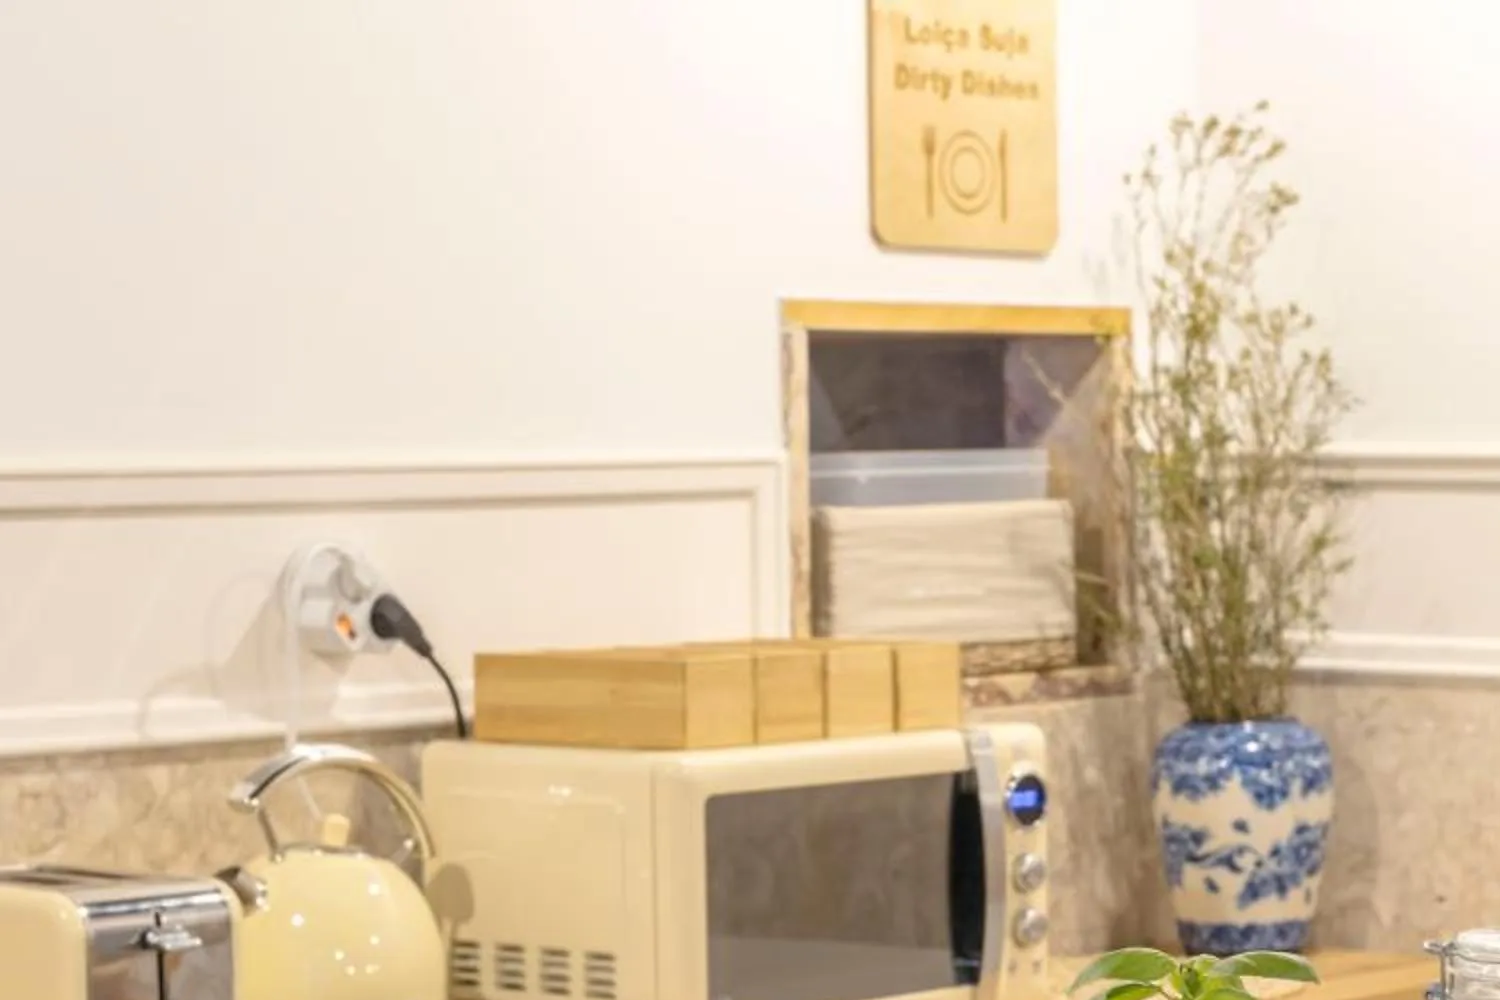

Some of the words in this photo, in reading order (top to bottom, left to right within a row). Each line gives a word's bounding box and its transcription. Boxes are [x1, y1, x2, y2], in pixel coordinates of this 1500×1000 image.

[904, 16, 970, 53] Loiça
[979, 23, 1029, 60] Suja
[895, 63, 950, 101] Dirty
[961, 69, 1039, 100] Dishes
